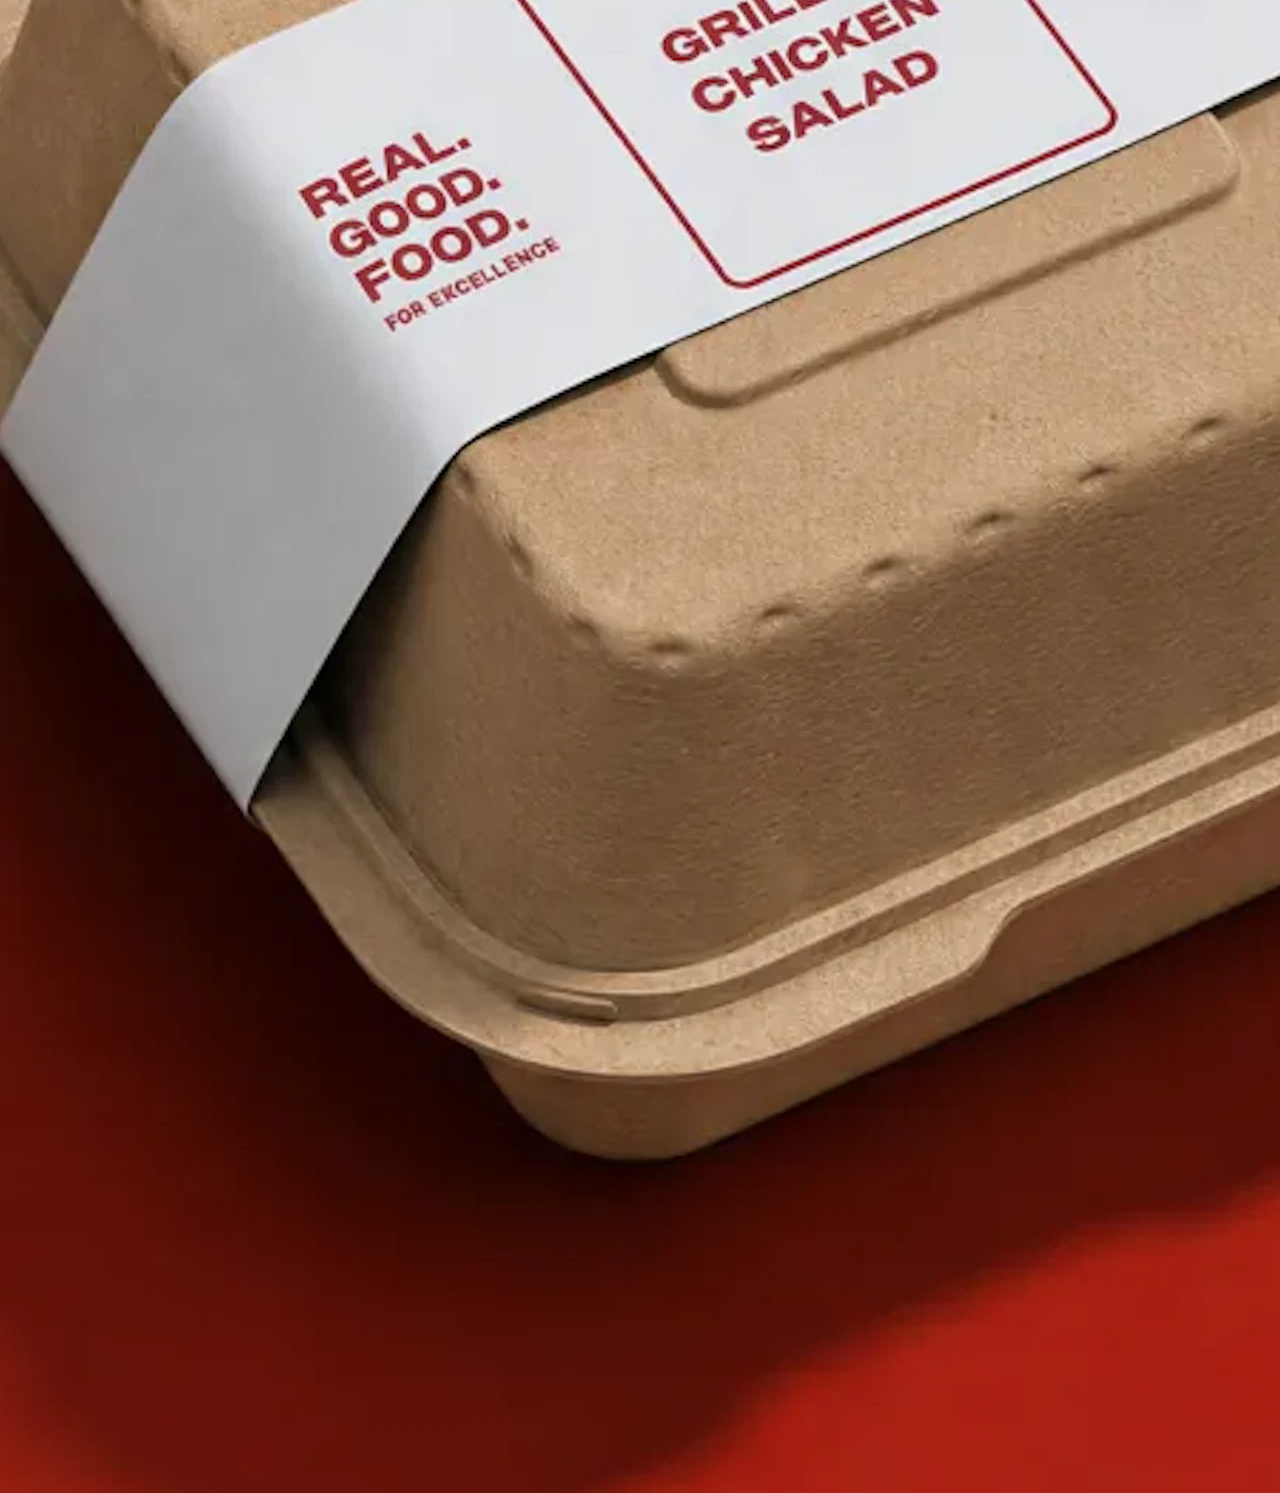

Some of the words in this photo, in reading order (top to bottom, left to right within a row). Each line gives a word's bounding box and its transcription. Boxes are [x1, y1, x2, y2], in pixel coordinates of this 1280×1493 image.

[747, 49, 939, 153] SALAD
[299, 132, 472, 219] REAL.
[329, 167, 502, 258] GOOD.
[353, 209, 529, 303] FOOD.
[383, 301, 426, 332] FOR
